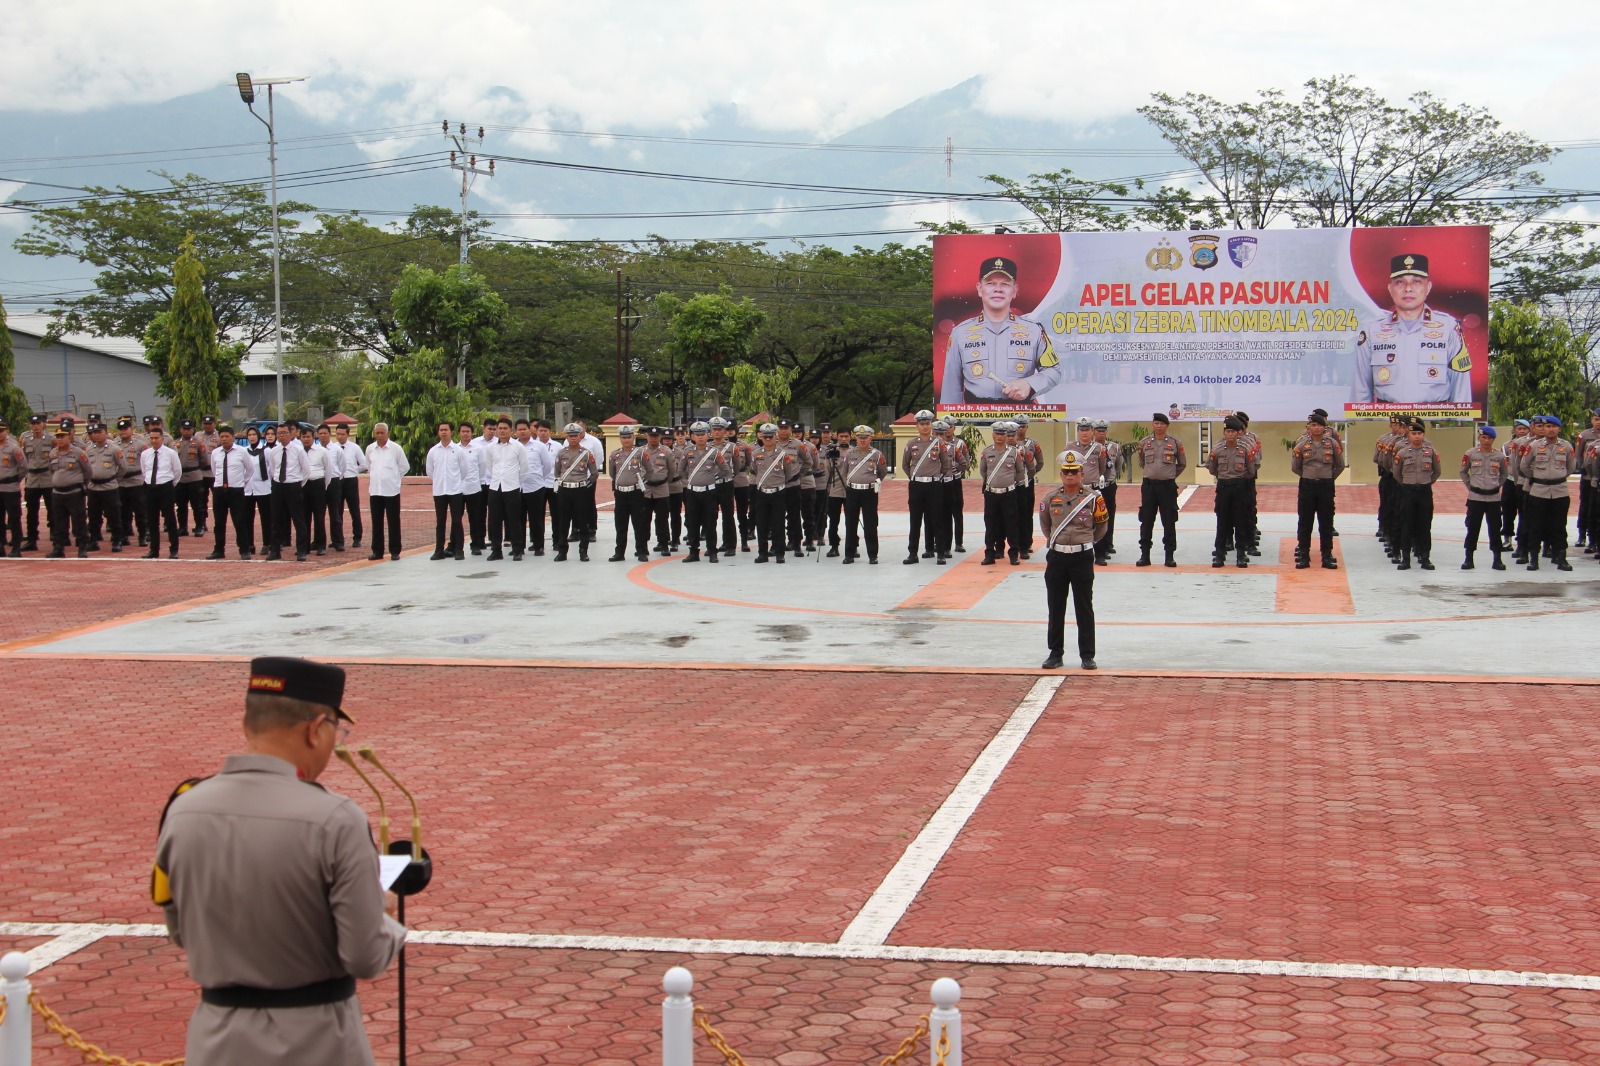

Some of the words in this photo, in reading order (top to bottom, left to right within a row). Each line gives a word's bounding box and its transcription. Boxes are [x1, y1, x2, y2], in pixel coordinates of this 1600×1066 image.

[1079, 283, 1136, 307] APEL
[1141, 282, 1215, 306] GELAR
[1219, 280, 1329, 305] PASUKAN
[1051, 311, 1132, 335] OPERASI
[1134, 310, 1197, 334] ZEBRA
[1199, 309, 1309, 333] TINOMBALA
[1312, 308, 1359, 332] 2024
[964, 341, 980, 349] AGUS
[1117, 342, 1160, 351] SUKSESNYA
[1160, 341, 1207, 351] PELANTIKAN
[1274, 340, 1312, 350] PRESIDEN
[1311, 340, 1346, 349] TERPILIH
[1373, 343, 1397, 351] SUSENO
[1103, 352, 1122, 361] DEMI
[1227, 352, 1251, 360] AMAN
[1251, 352, 1268, 360] DAN
[1144, 375, 1175, 386] Senin,
[1177, 375, 1190, 384] 14
[1193, 375, 1232, 384] Oktober
[1235, 375, 1262, 384] 2024
